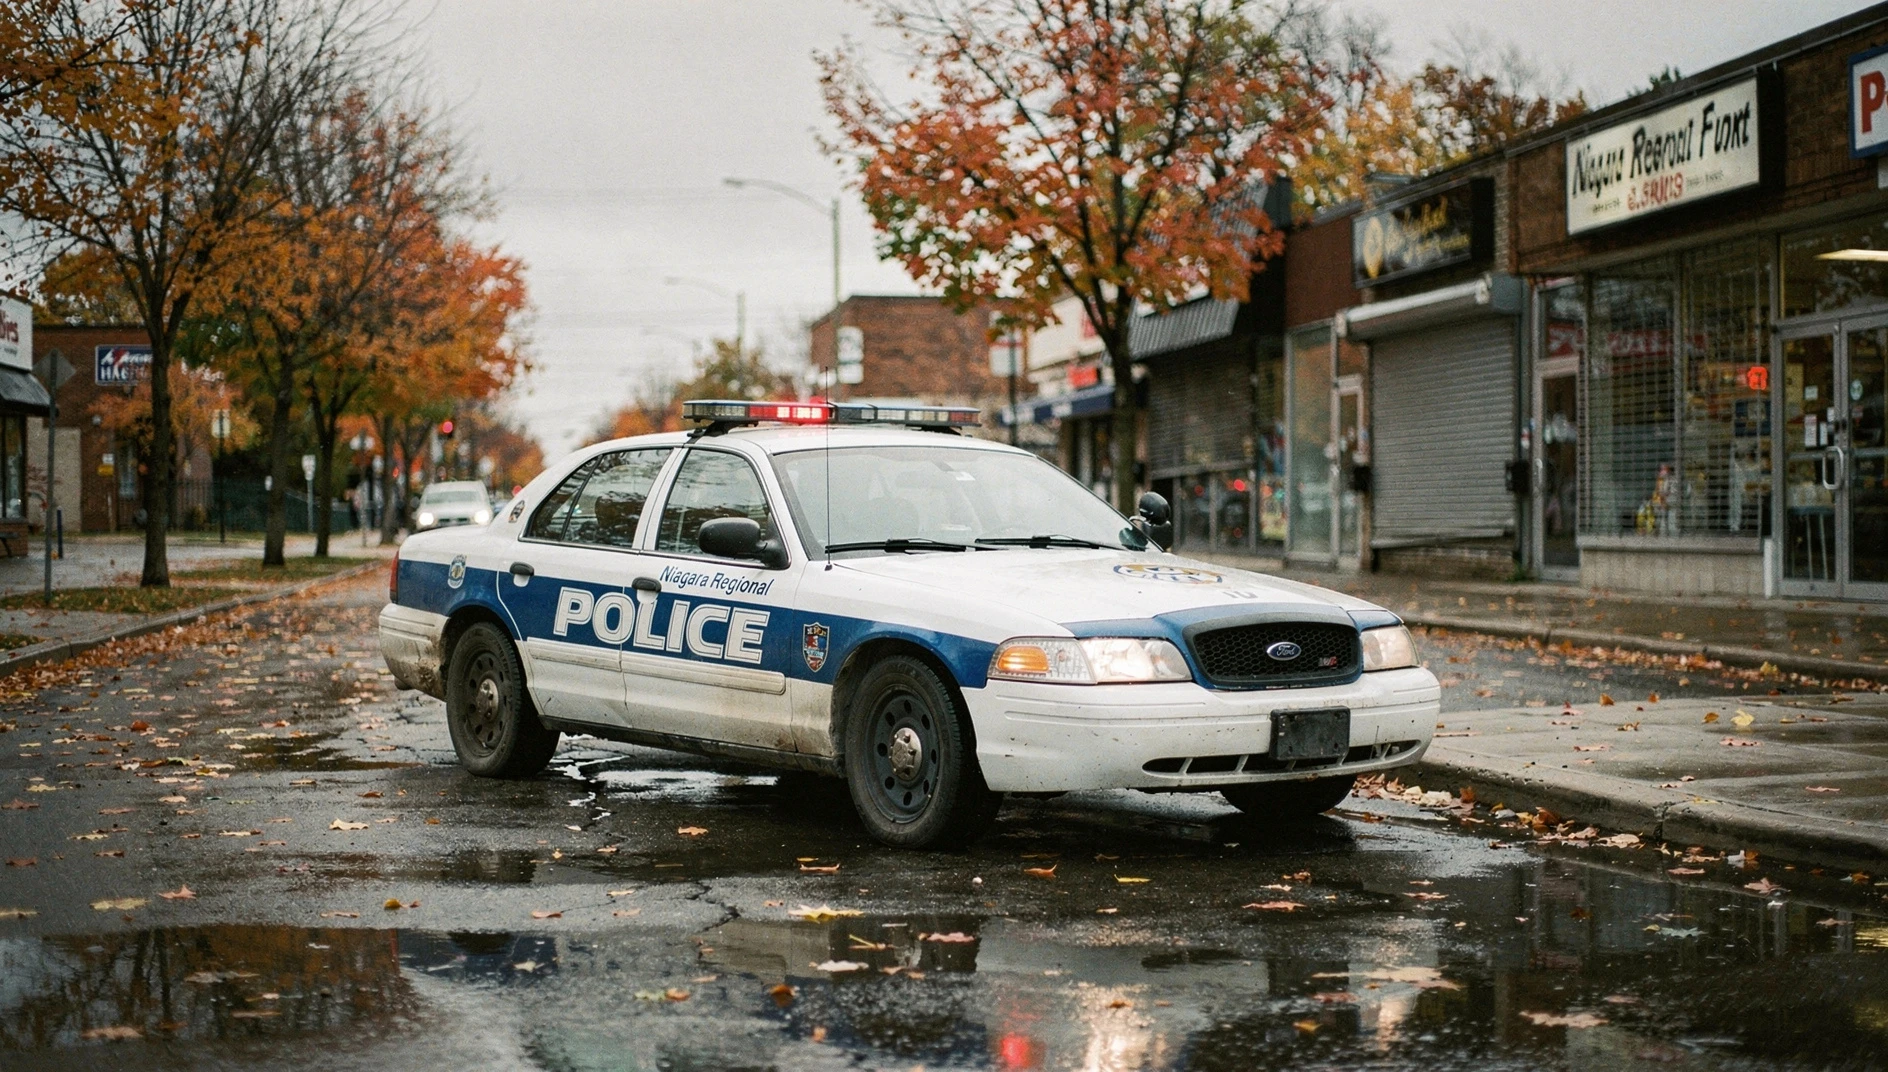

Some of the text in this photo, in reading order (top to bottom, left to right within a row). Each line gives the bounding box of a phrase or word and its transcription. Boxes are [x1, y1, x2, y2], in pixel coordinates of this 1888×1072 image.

[1860, 70, 1888, 135] P
[660, 565, 775, 596] Niagara Regional
[553, 586, 770, 664] POLICE
